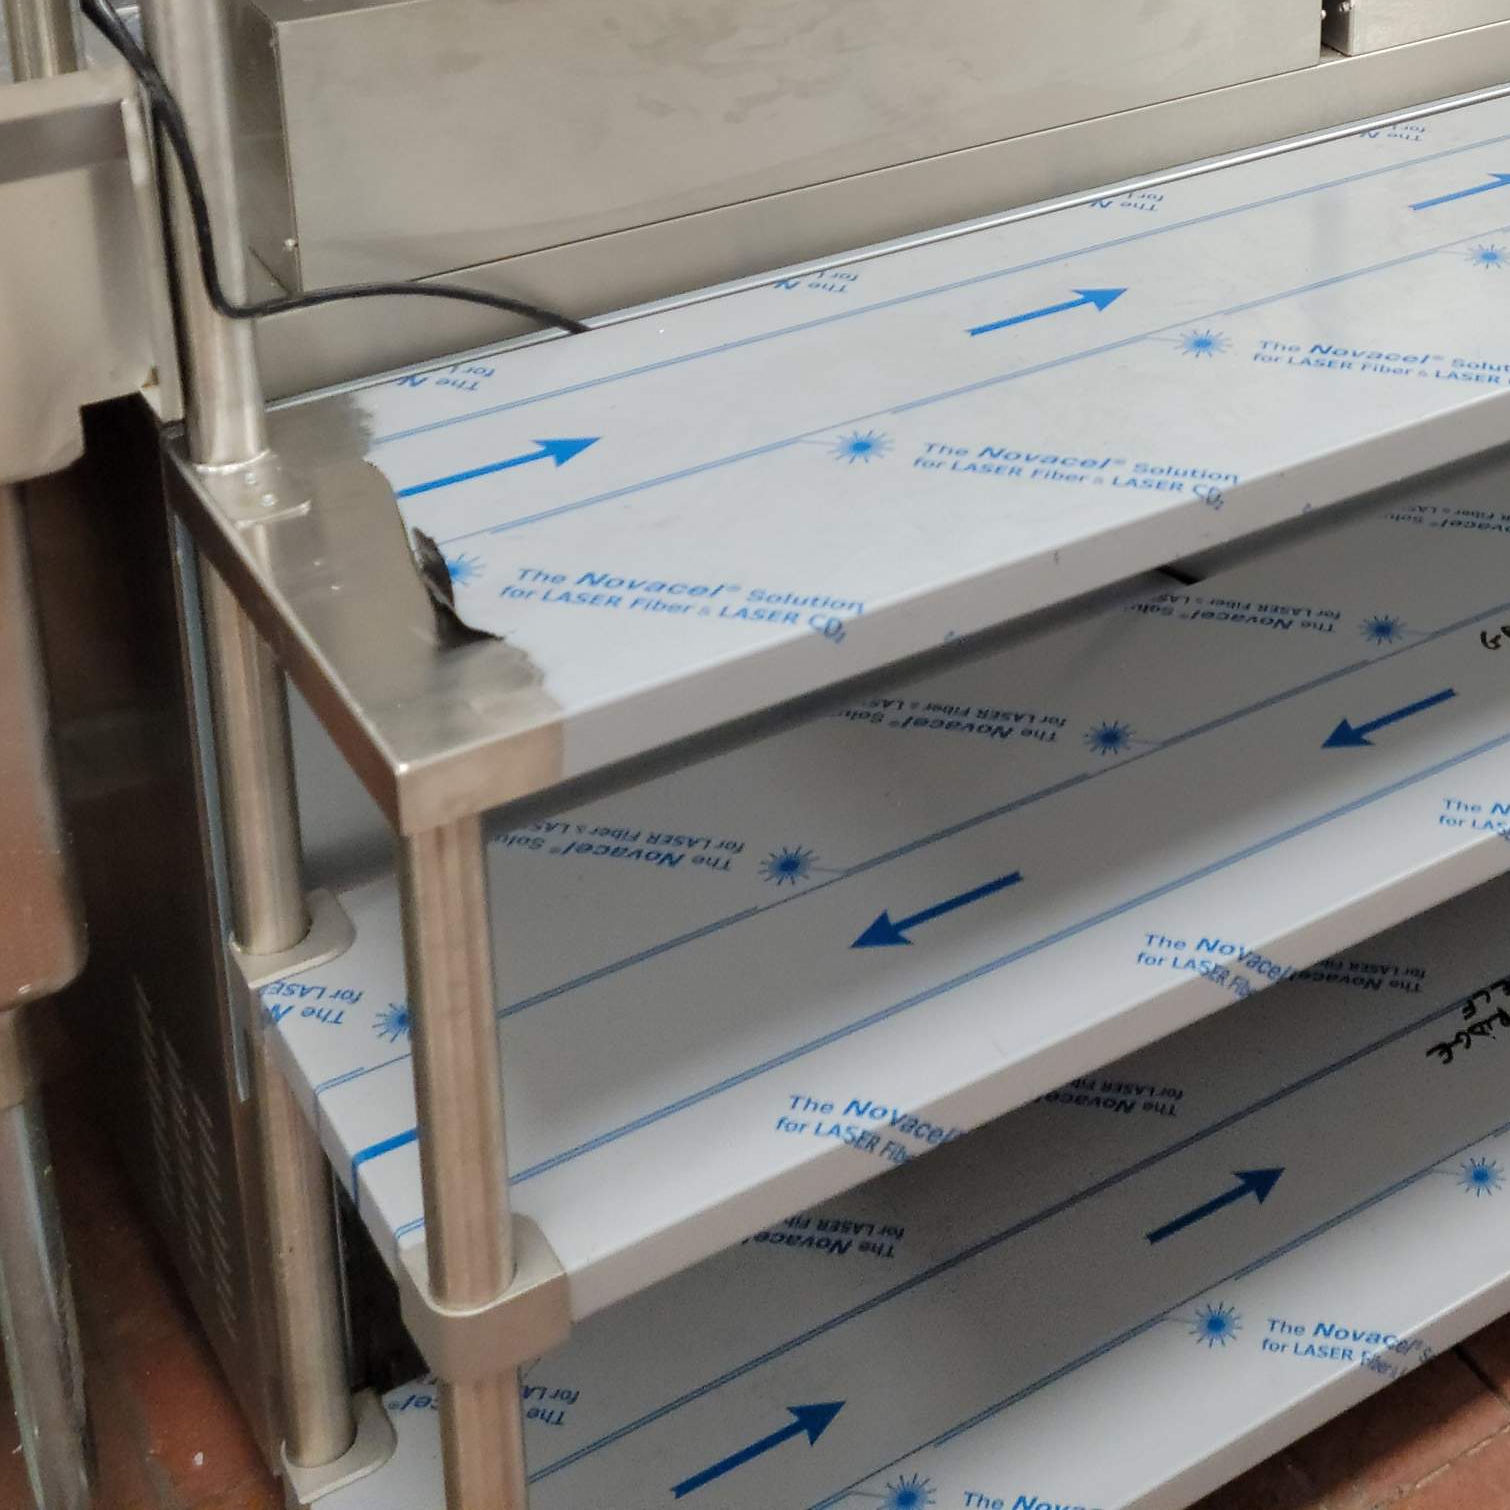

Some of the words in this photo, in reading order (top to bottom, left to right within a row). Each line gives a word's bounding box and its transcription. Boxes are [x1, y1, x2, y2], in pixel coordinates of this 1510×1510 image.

[1260, 340, 1301, 353] The
[1252, 352, 1280, 364] for
[1287, 355, 1353, 371] LASER
[1360, 362, 1411, 376] Fiber
[1434, 369, 1500, 385] LASER
[923, 442, 969, 457] The
[1133, 462, 1241, 484] Solution
[912, 457, 945, 470] for
[950, 461, 1023, 478] LASER
[1030, 467, 1088, 484] Fiber
[1111, 475, 1183, 492] LASER
[517, 568, 566, 585] The
[746, 588, 865, 614] Solution
[500, 585, 536, 601] for
[541, 589, 621, 609] LASER
[629, 596, 691, 614] Fiber
[718, 606, 799, 625] LASER
[1441, 797, 1483, 814] The
[1143, 932, 1187, 951] The
[787, 1094, 834, 1115] The
[775, 1115, 810, 1133] for
[1266, 1317, 1306, 1339] The
[1291, 1342, 1355, 1363] LASER
